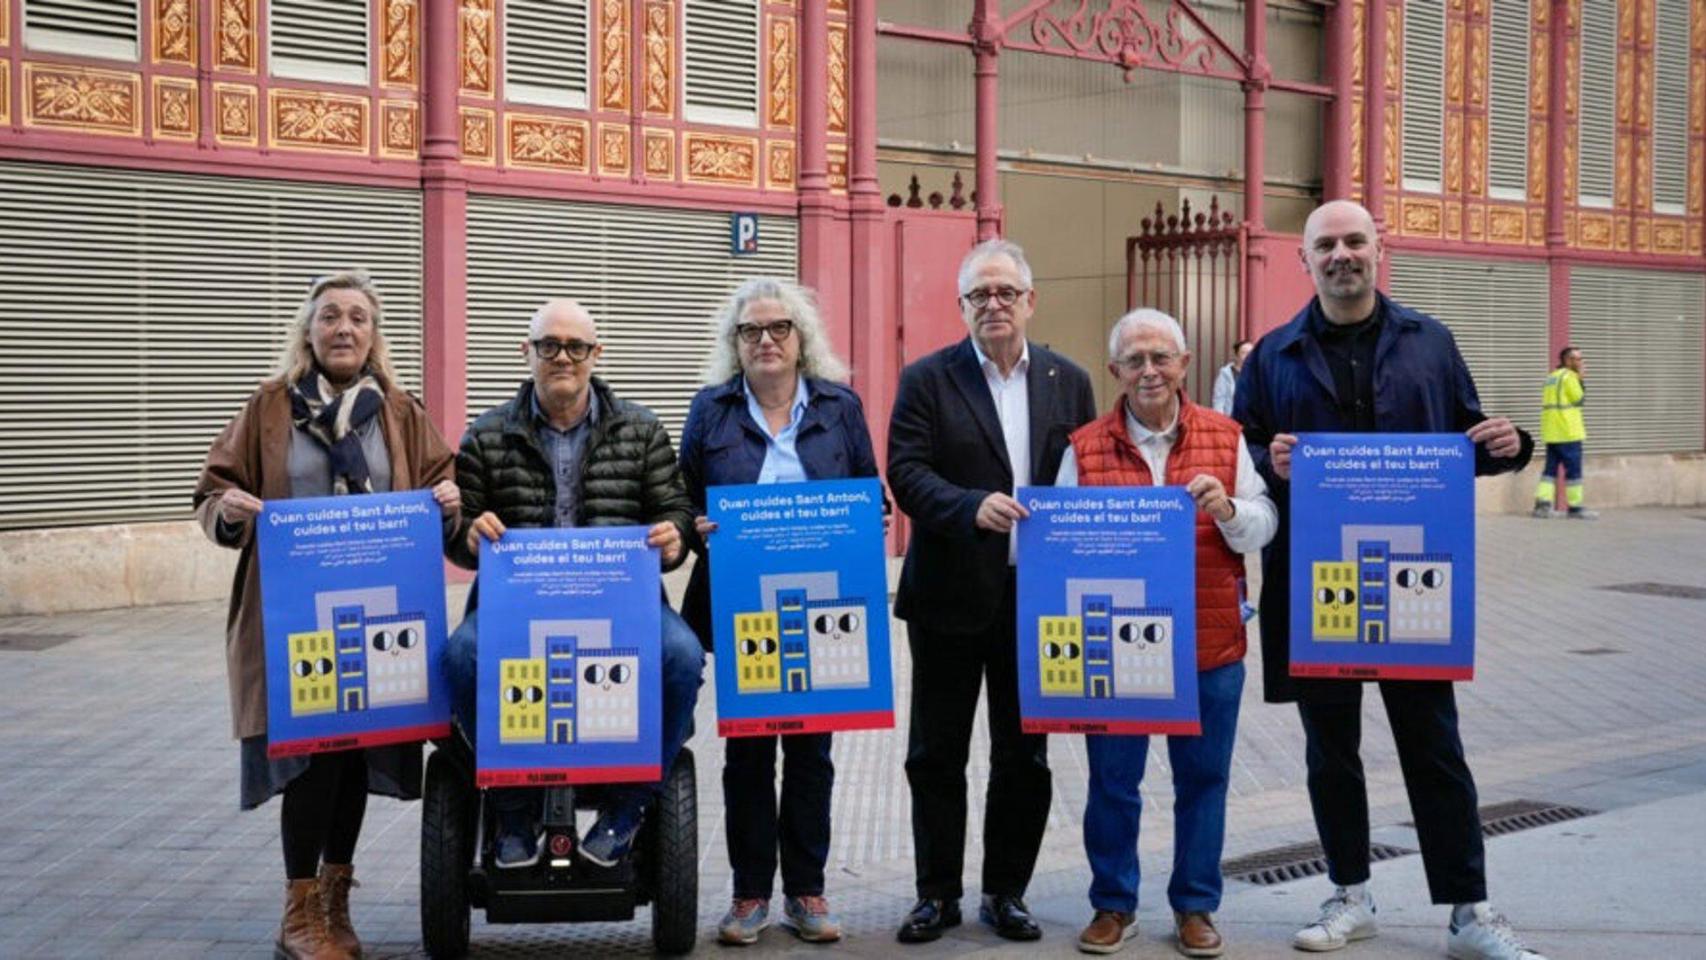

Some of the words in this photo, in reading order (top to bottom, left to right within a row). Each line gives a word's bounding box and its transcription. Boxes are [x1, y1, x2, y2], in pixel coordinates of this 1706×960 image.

[739, 216, 755, 250] P
[1303, 445, 1335, 458] Quan
[1338, 445, 1380, 456] cuides
[1383, 445, 1413, 456] Sant
[1325, 459, 1367, 469] cuides
[1370, 459, 1381, 469] el
[1385, 459, 1406, 469] teu
[1409, 459, 1439, 469] barri
[719, 498, 750, 511] Quan
[753, 496, 793, 508] cuides
[796, 494, 824, 505] Sant
[1029, 499, 1061, 510] Quan
[1064, 498, 1103, 510] cuides
[1106, 499, 1135, 509] Sant
[269, 512, 303, 526] Quan
[307, 511, 349, 521] cuides
[351, 506, 385, 517] Sant
[741, 510, 780, 521] cuides
[784, 509, 794, 519] el
[798, 508, 817, 518] teu
[820, 506, 849, 517] barri
[1050, 512, 1090, 523] cuides
[1094, 512, 1104, 523] el
[1108, 513, 1128, 523] teu
[1131, 512, 1161, 523] barri
[294, 525, 336, 536] cuides
[340, 522, 350, 532] el
[354, 521, 376, 531] teu
[379, 518, 408, 530] barri
[492, 543, 523, 553] Quan
[526, 539, 568, 551] cuides
[572, 539, 600, 550] Sant
[513, 553, 554, 564] cuides
[558, 553, 570, 563] el
[573, 553, 593, 563] teu
[596, 552, 627, 562] barri
